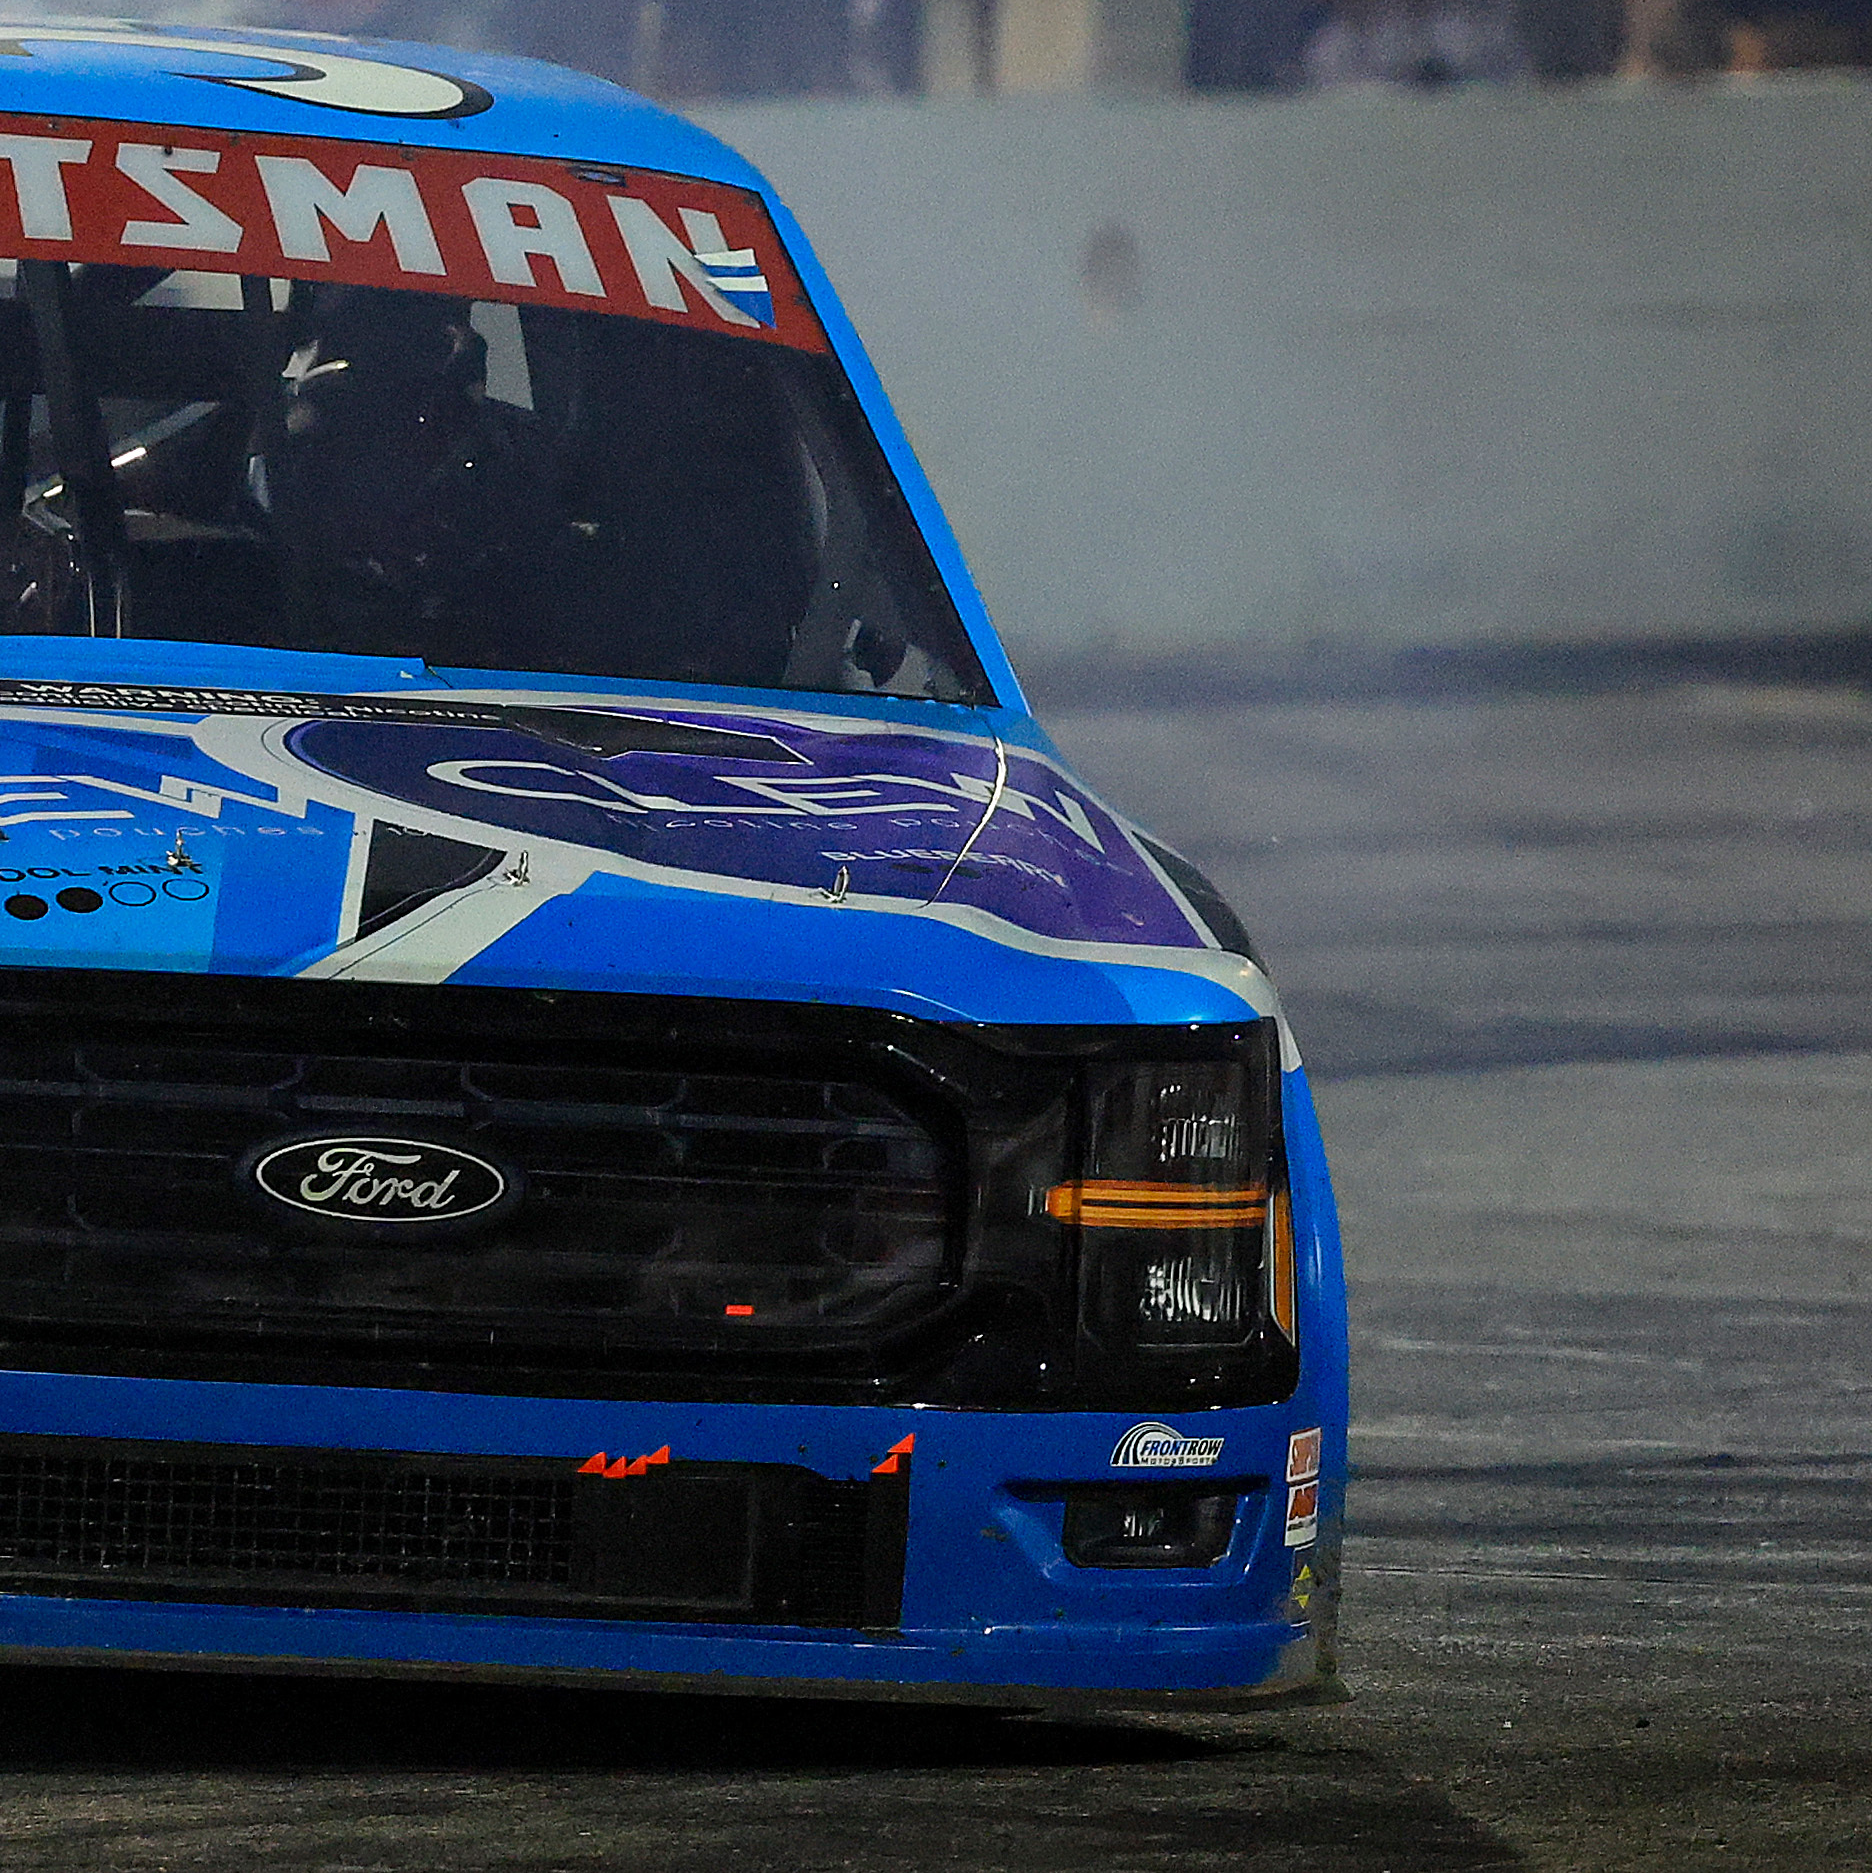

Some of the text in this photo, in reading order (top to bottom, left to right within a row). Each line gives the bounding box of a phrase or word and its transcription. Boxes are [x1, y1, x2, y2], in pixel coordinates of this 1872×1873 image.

[21, 683, 320, 705] WARNING:
[427, 759, 1106, 854] CLEW
[48, 823, 325, 841] pouches
[300, 1147, 460, 1209] Ford
